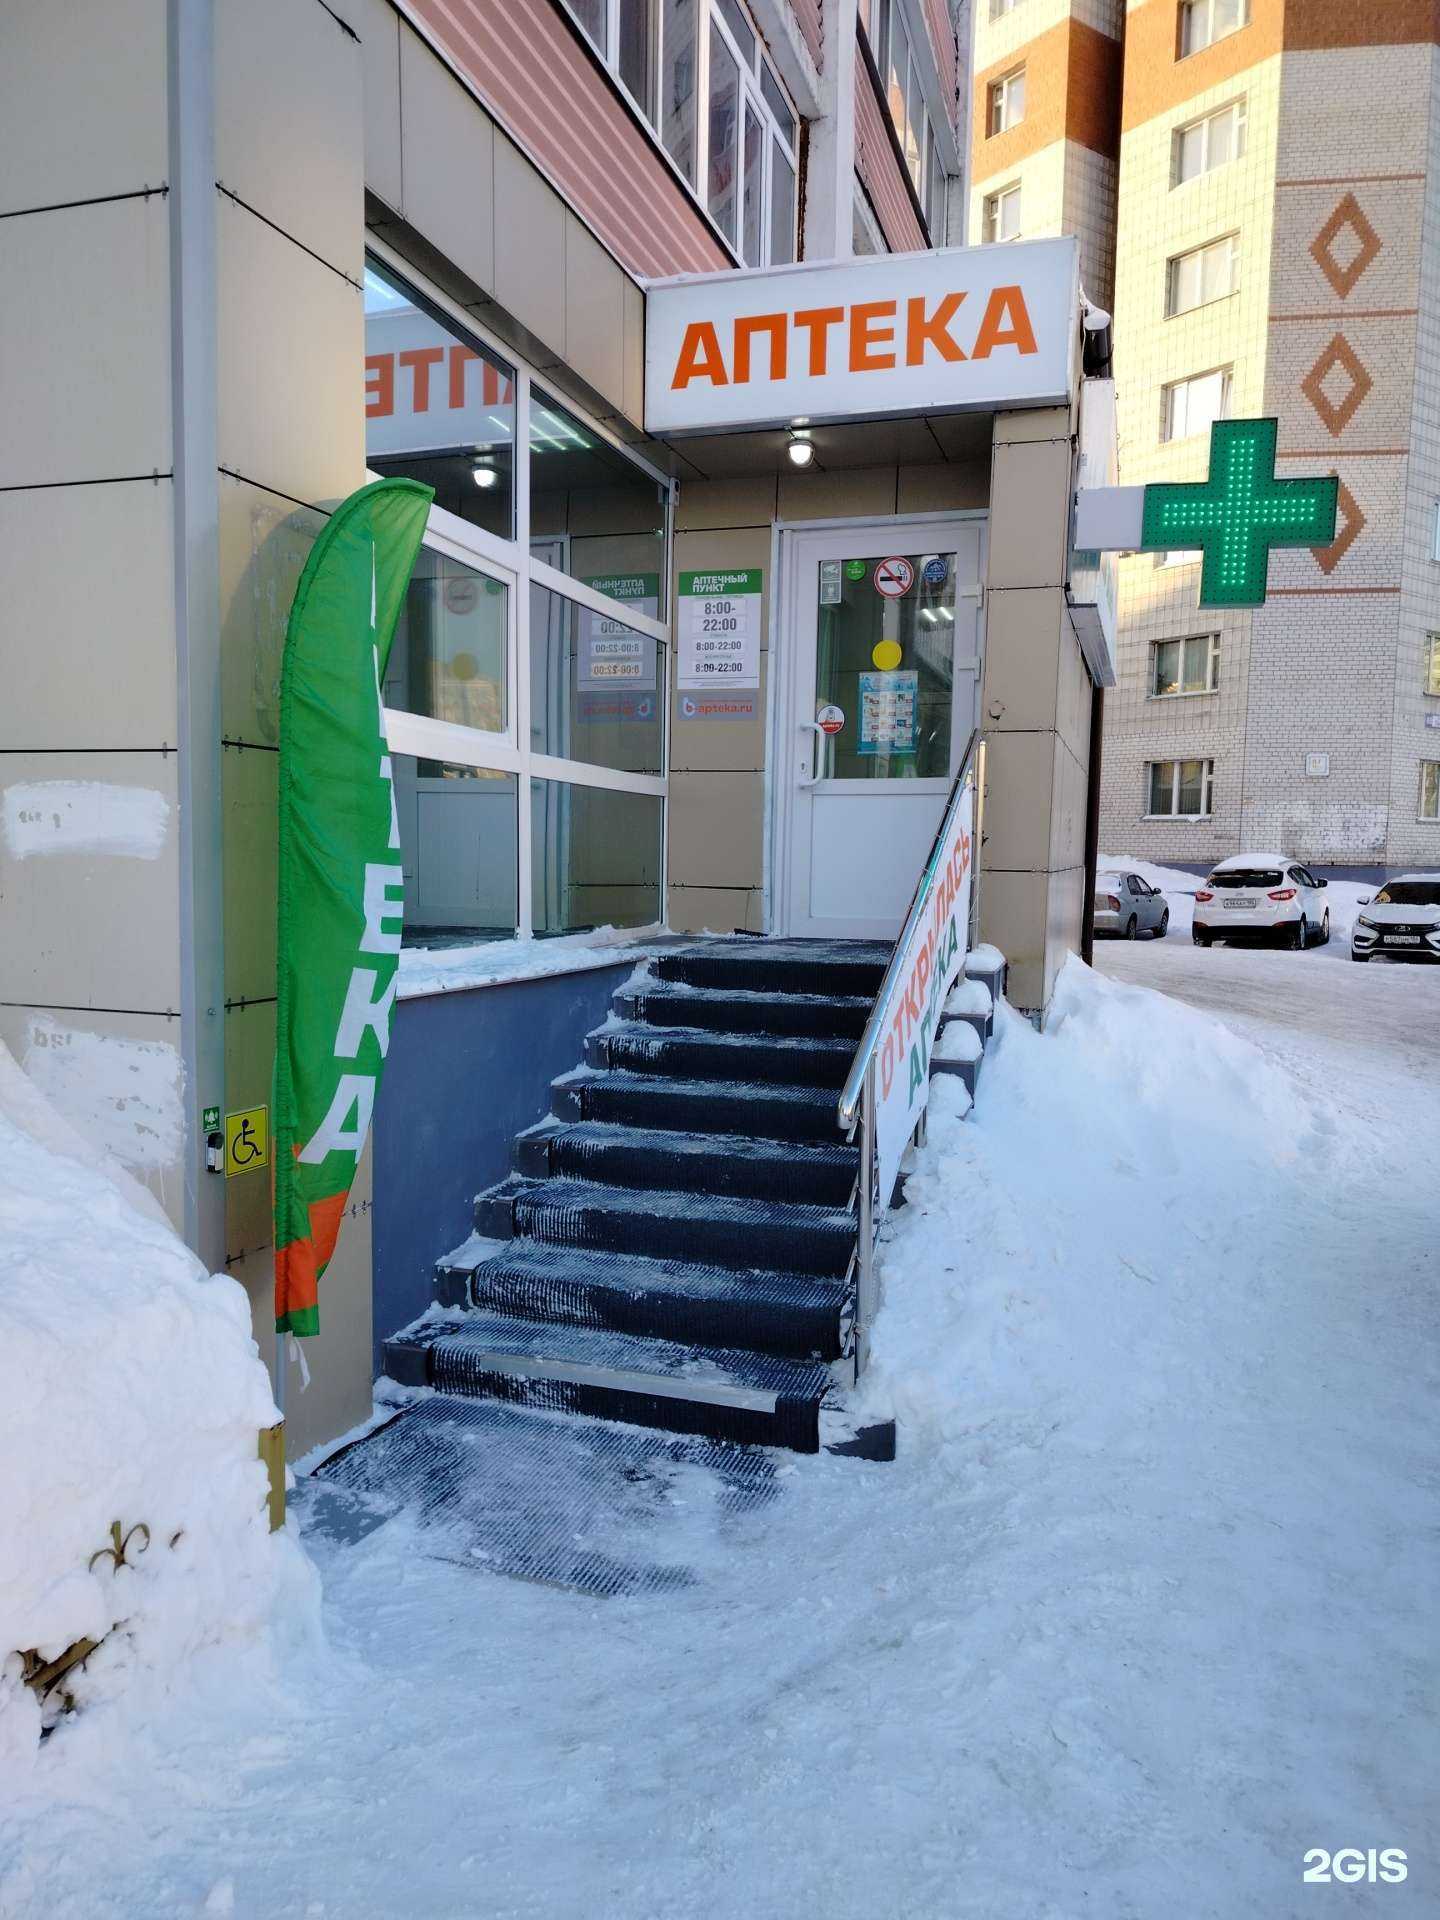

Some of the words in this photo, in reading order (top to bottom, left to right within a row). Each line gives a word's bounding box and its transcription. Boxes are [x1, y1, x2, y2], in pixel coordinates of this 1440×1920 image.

[670, 285, 1039, 390] АПТЕКА
[692, 573, 748, 585] АПТЕЧНЫЙ
[692, 584, 725, 593] ПУНКТ
[704, 601, 736, 615] 8:00-
[702, 617, 737, 632] 22:00
[695, 640, 742, 651] 8:00-22:00
[695, 662, 743, 673] 8:00-22:00
